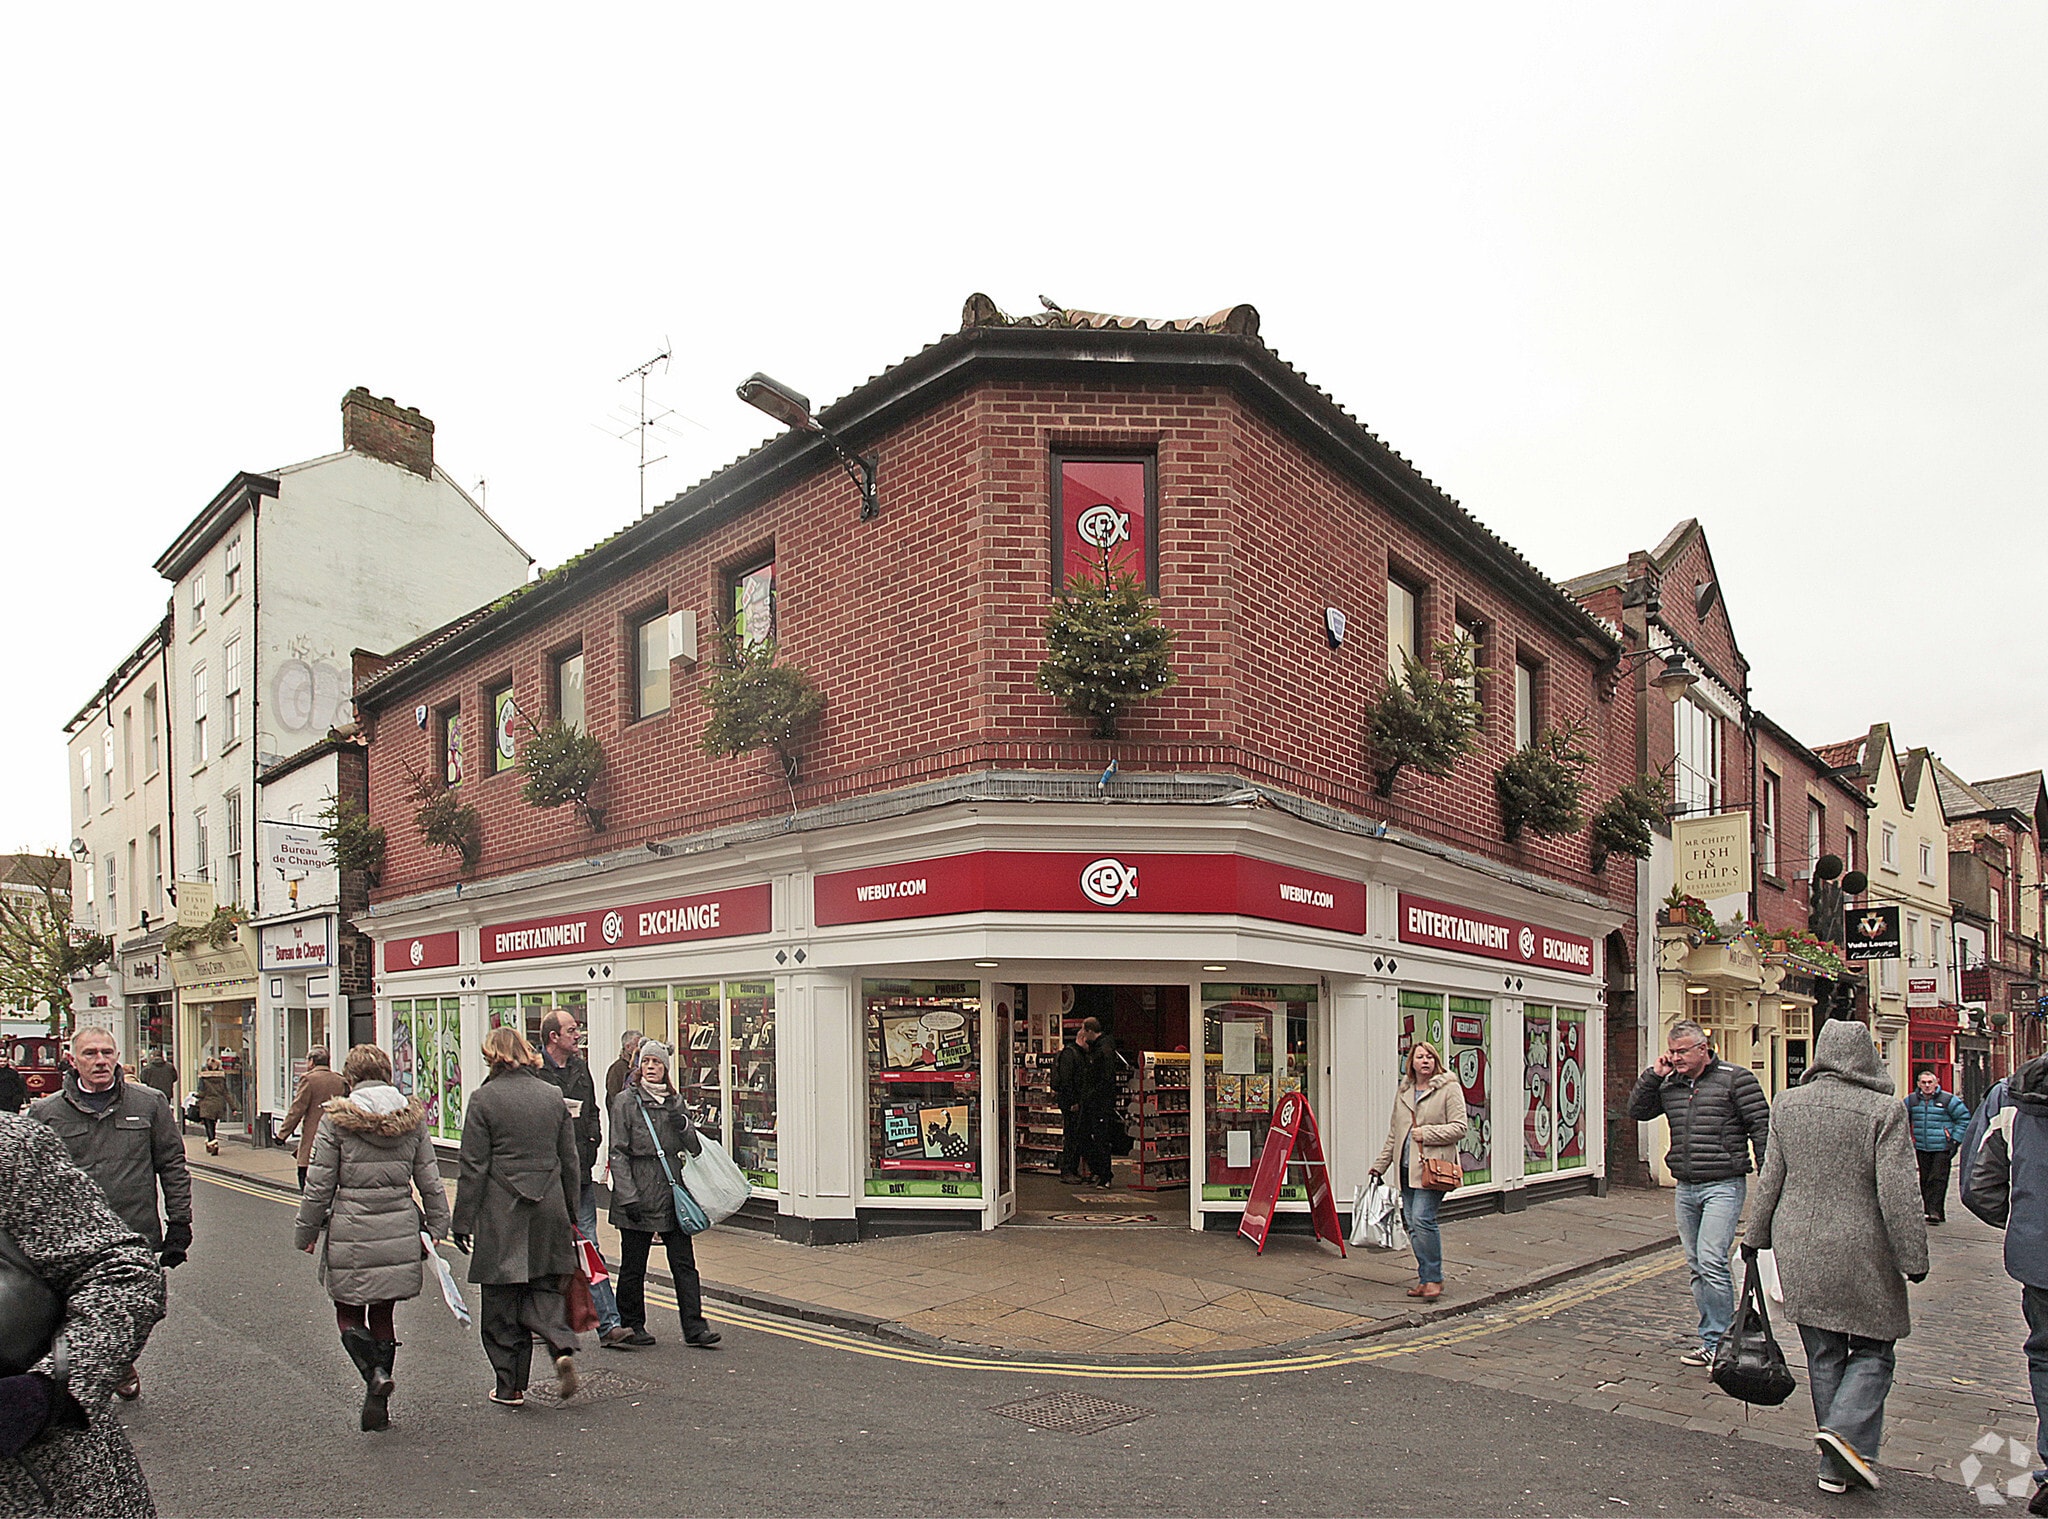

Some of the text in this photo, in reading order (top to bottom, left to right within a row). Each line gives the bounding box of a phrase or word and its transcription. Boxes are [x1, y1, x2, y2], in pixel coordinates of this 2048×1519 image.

[1701, 835, 1737, 845] CHIPPY
[281, 843, 318, 856] Bureau
[1693, 847, 1729, 860] FISH
[273, 854, 327, 869] de Change
[1706, 859, 1715, 868] &
[1685, 866, 1739, 880] CHIPS
[857, 878, 927, 902] WEBUY.COM
[1687, 881, 1738, 890] RESTAURANT
[1279, 883, 1334, 909] WEBUY.COM
[184, 909, 209, 918] CHIPS
[495, 921, 587, 953] ENTERTAINMENT
[638, 903, 720, 936] EXCHANGE
[1408, 907, 1510, 950] ENTERTAINMENT
[1543, 937, 1590, 966] EXCHANGE
[1848, 940, 1898, 949] Vudu Lounge
[275, 944, 295, 961] Bureau
[295, 943, 303, 960] de
[303, 941, 326, 962] Change
[935, 984, 966, 994] PHONES
[1267, 987, 1278, 998] TV
[942, 1046, 968, 1058] PHONES
[1788, 1056, 1800, 1064] FISH
[891, 1127, 916, 1137] PLAYERS
[889, 1183, 905, 1194] BUY
[941, 1184, 959, 1194] SELL
[1229, 1188, 1242, 1197] WE
